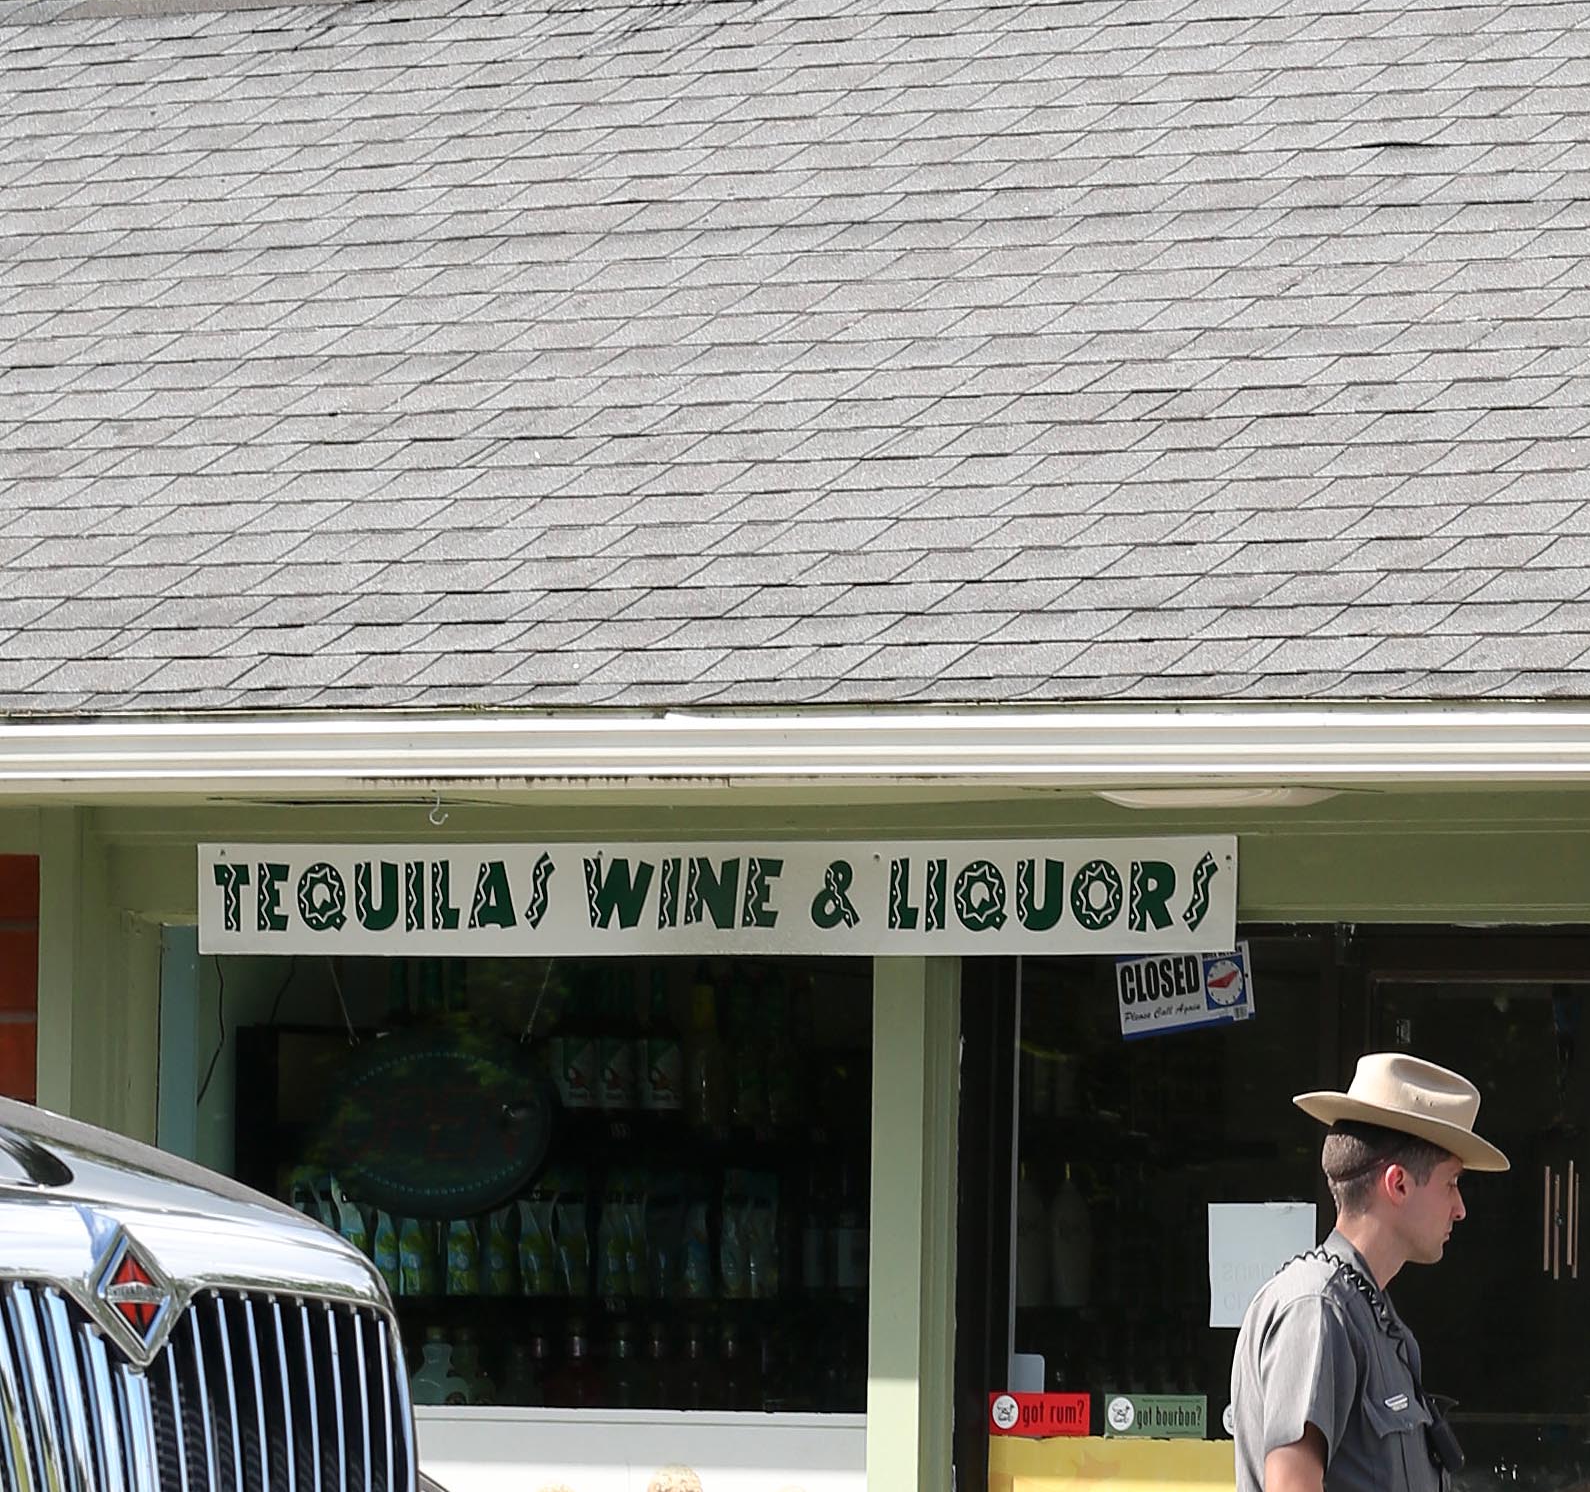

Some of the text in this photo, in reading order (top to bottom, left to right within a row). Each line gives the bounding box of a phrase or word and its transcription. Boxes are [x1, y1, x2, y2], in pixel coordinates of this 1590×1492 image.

[212, 851, 1219, 935] TEQUILAS WINE & LIQUORS
[1120, 955, 1200, 1005] CLOSED
[1022, 1397, 1084, 1427] got rum?
[1137, 1405, 1202, 1430] got bourbon?
